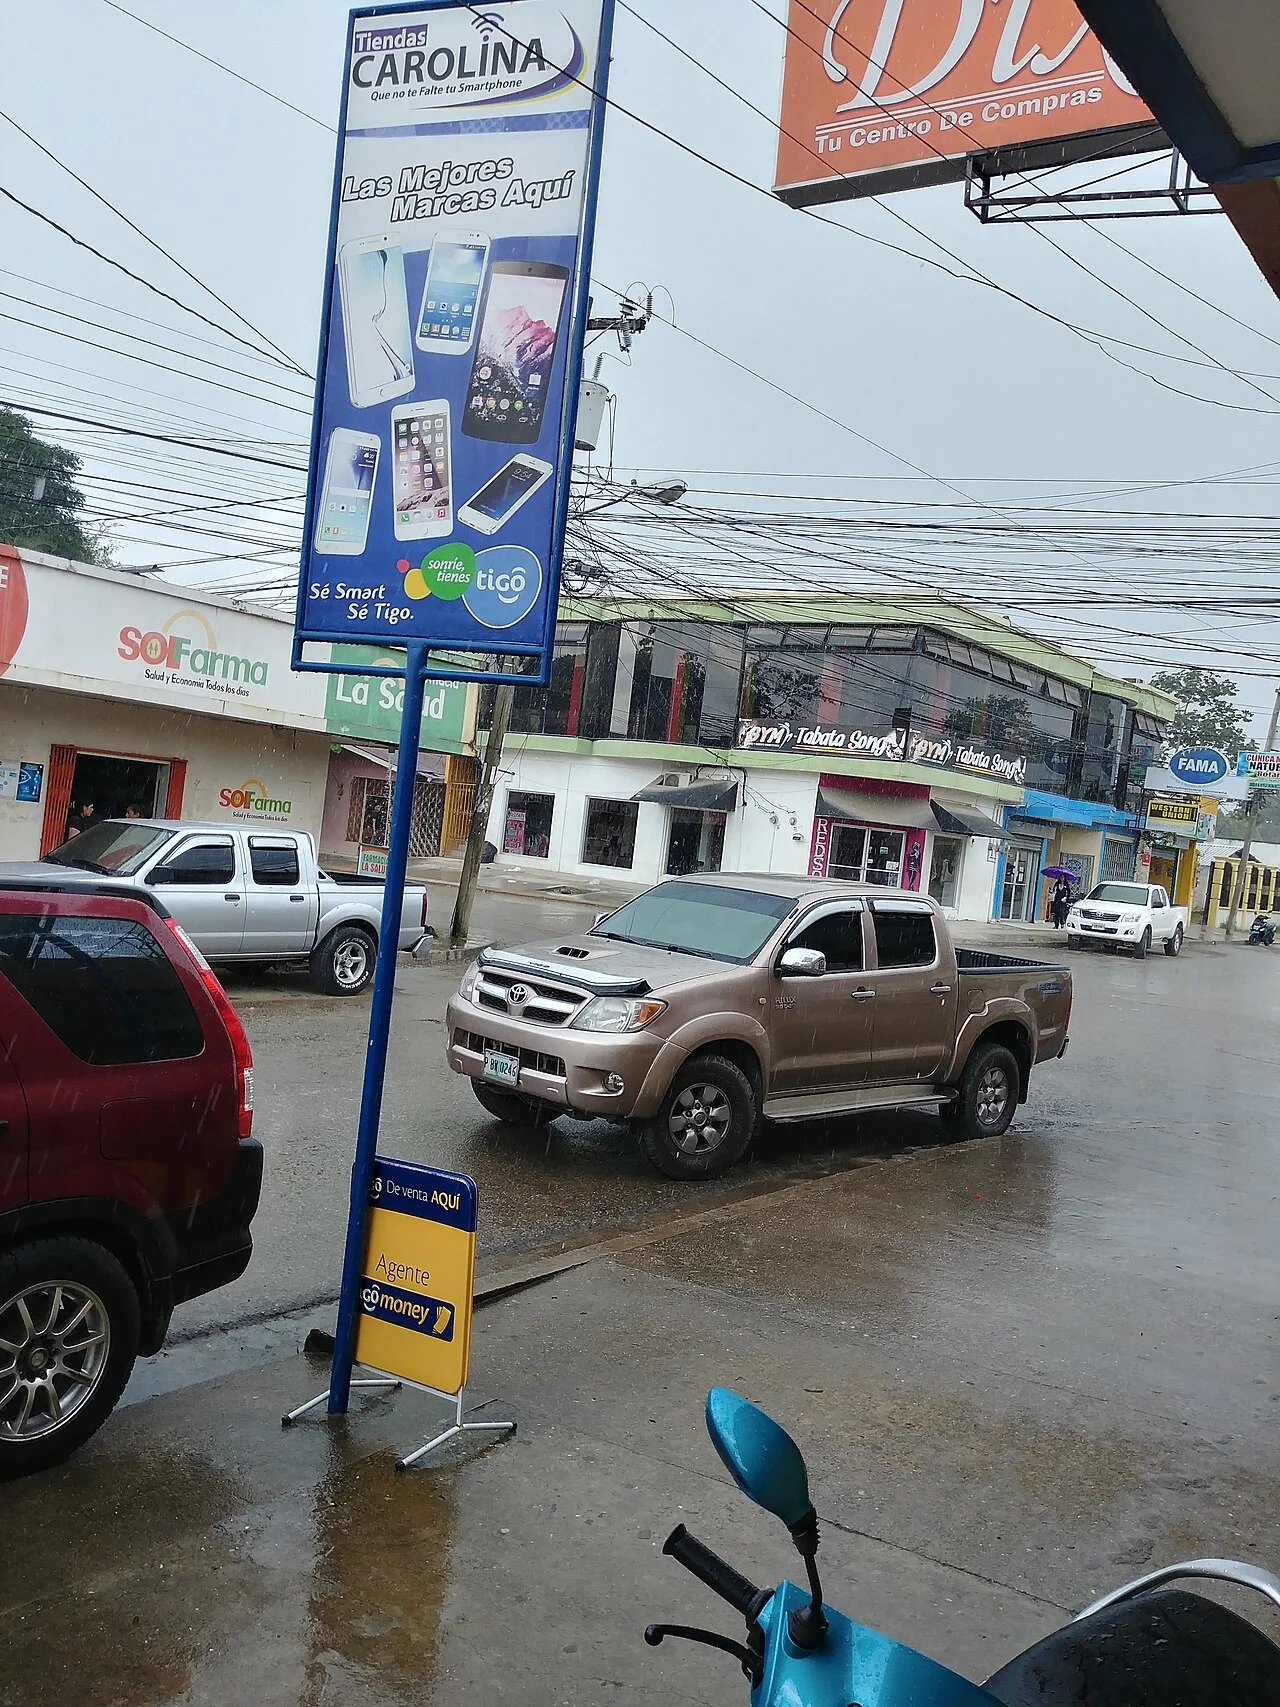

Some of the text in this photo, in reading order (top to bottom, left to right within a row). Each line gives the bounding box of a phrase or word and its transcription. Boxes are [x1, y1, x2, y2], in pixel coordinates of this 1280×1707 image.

[356, 29, 426, 52] Tiendas
[352, 37, 546, 88] CAROLINA
[370, 79, 523, 102] Que no te Falte tu Smartphone
[814, 85, 1103, 154] Tu Centro De Compras
[342, 157, 514, 202] Las Mejores
[390, 170, 576, 222] Marcas Aquí
[427, 556, 466, 572] sonríe,
[436, 569, 471, 583] tienes
[309, 582, 386, 600] Sé Smart
[346, 602, 415, 625] Sé Tigo.
[117, 626, 269, 686] SOLFarma
[144, 668, 165, 681] Salud
[166, 675, 171, 685] y
[205, 679, 225, 693] Todos
[225, 683, 236, 695] los
[336, 673, 369, 705] La
[796, 727, 846, 747] Tabata
[955, 745, 990, 768] Tabata
[1178, 758, 1218, 774] FAMA
[219, 788, 292, 813] SOLFarma
[1151, 804, 1190, 814] WESTERN
[1162, 810, 1190, 820] UNION
[362, 862, 386, 874] LA SALU
[363, 854, 388, 865] FARMACI
[386, 1180, 400, 1196] De
[402, 1186, 428, 1202] venta
[431, 1190, 461, 1211] AQUÍ
[375, 1253, 430, 1286] Agente
